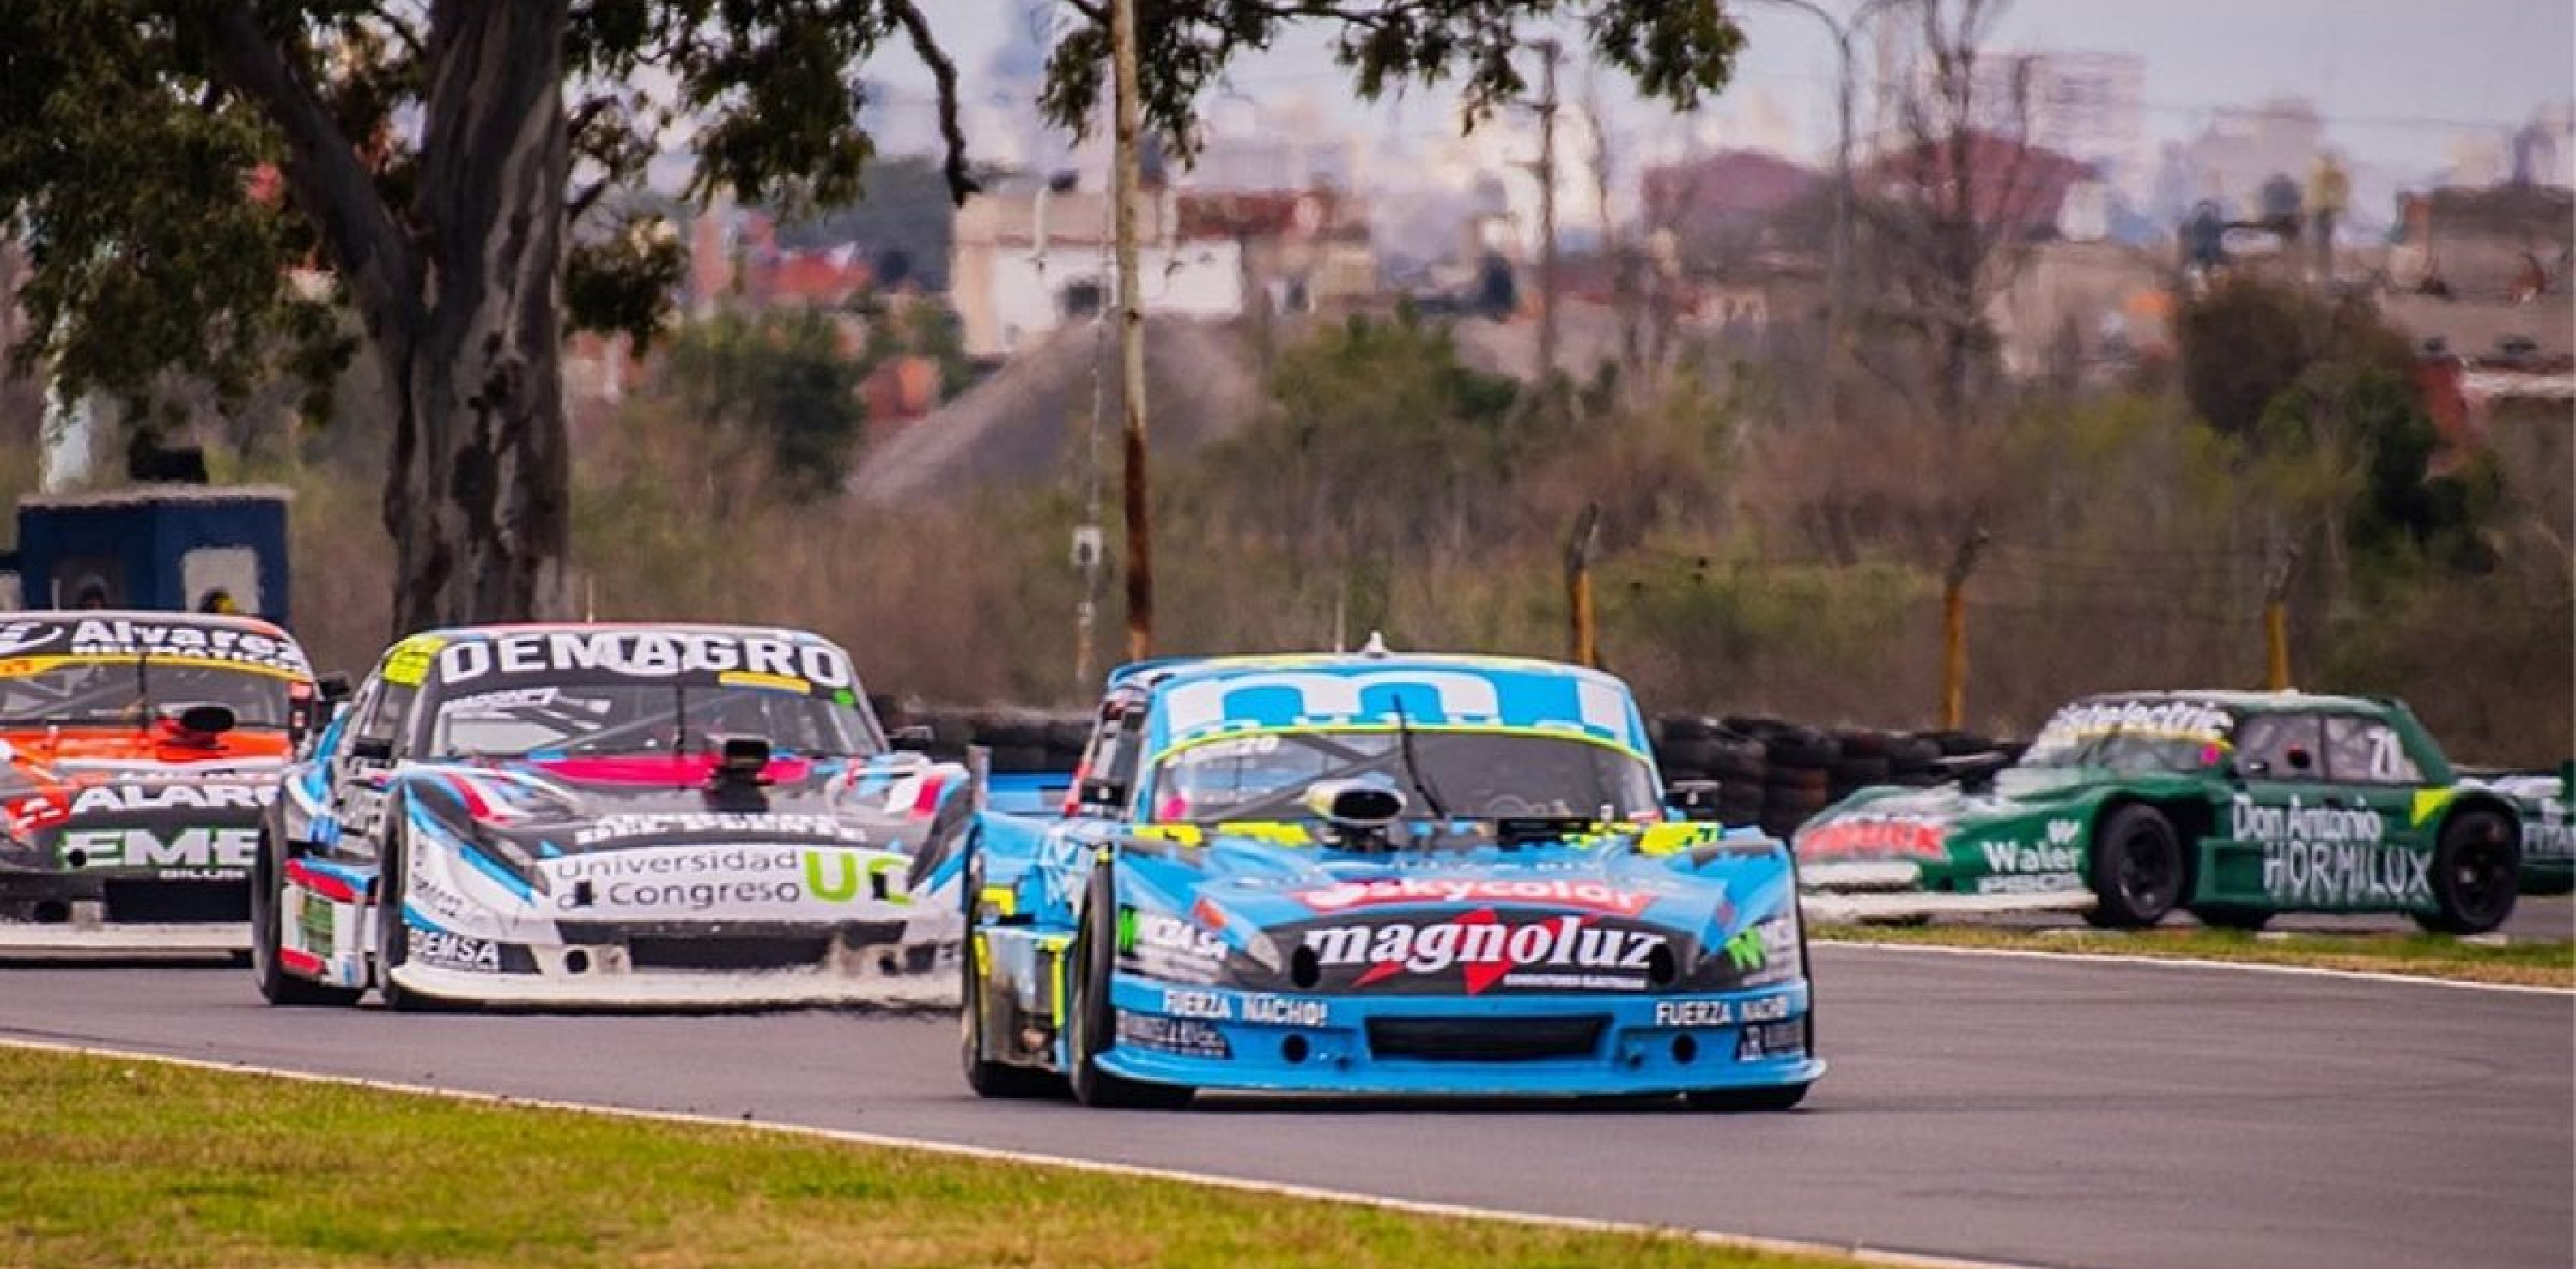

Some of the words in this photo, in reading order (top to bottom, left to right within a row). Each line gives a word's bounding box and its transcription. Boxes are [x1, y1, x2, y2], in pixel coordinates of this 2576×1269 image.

[439, 633, 850, 684] DEMAGRO
[2232, 792, 2282, 841] Don
[2287, 792, 2383, 843] Antonio
[556, 848, 798, 878] Universidad
[2262, 841, 2433, 896] HORMILUX
[556, 882, 599, 912] d
[608, 881, 800, 909] Congreso
[1304, 916, 1668, 973] magnoluz
[1163, 989, 1233, 1019] FUERZA
[1242, 992, 1327, 1027] NACHO!
[1656, 999, 1733, 1026] FUERZA
